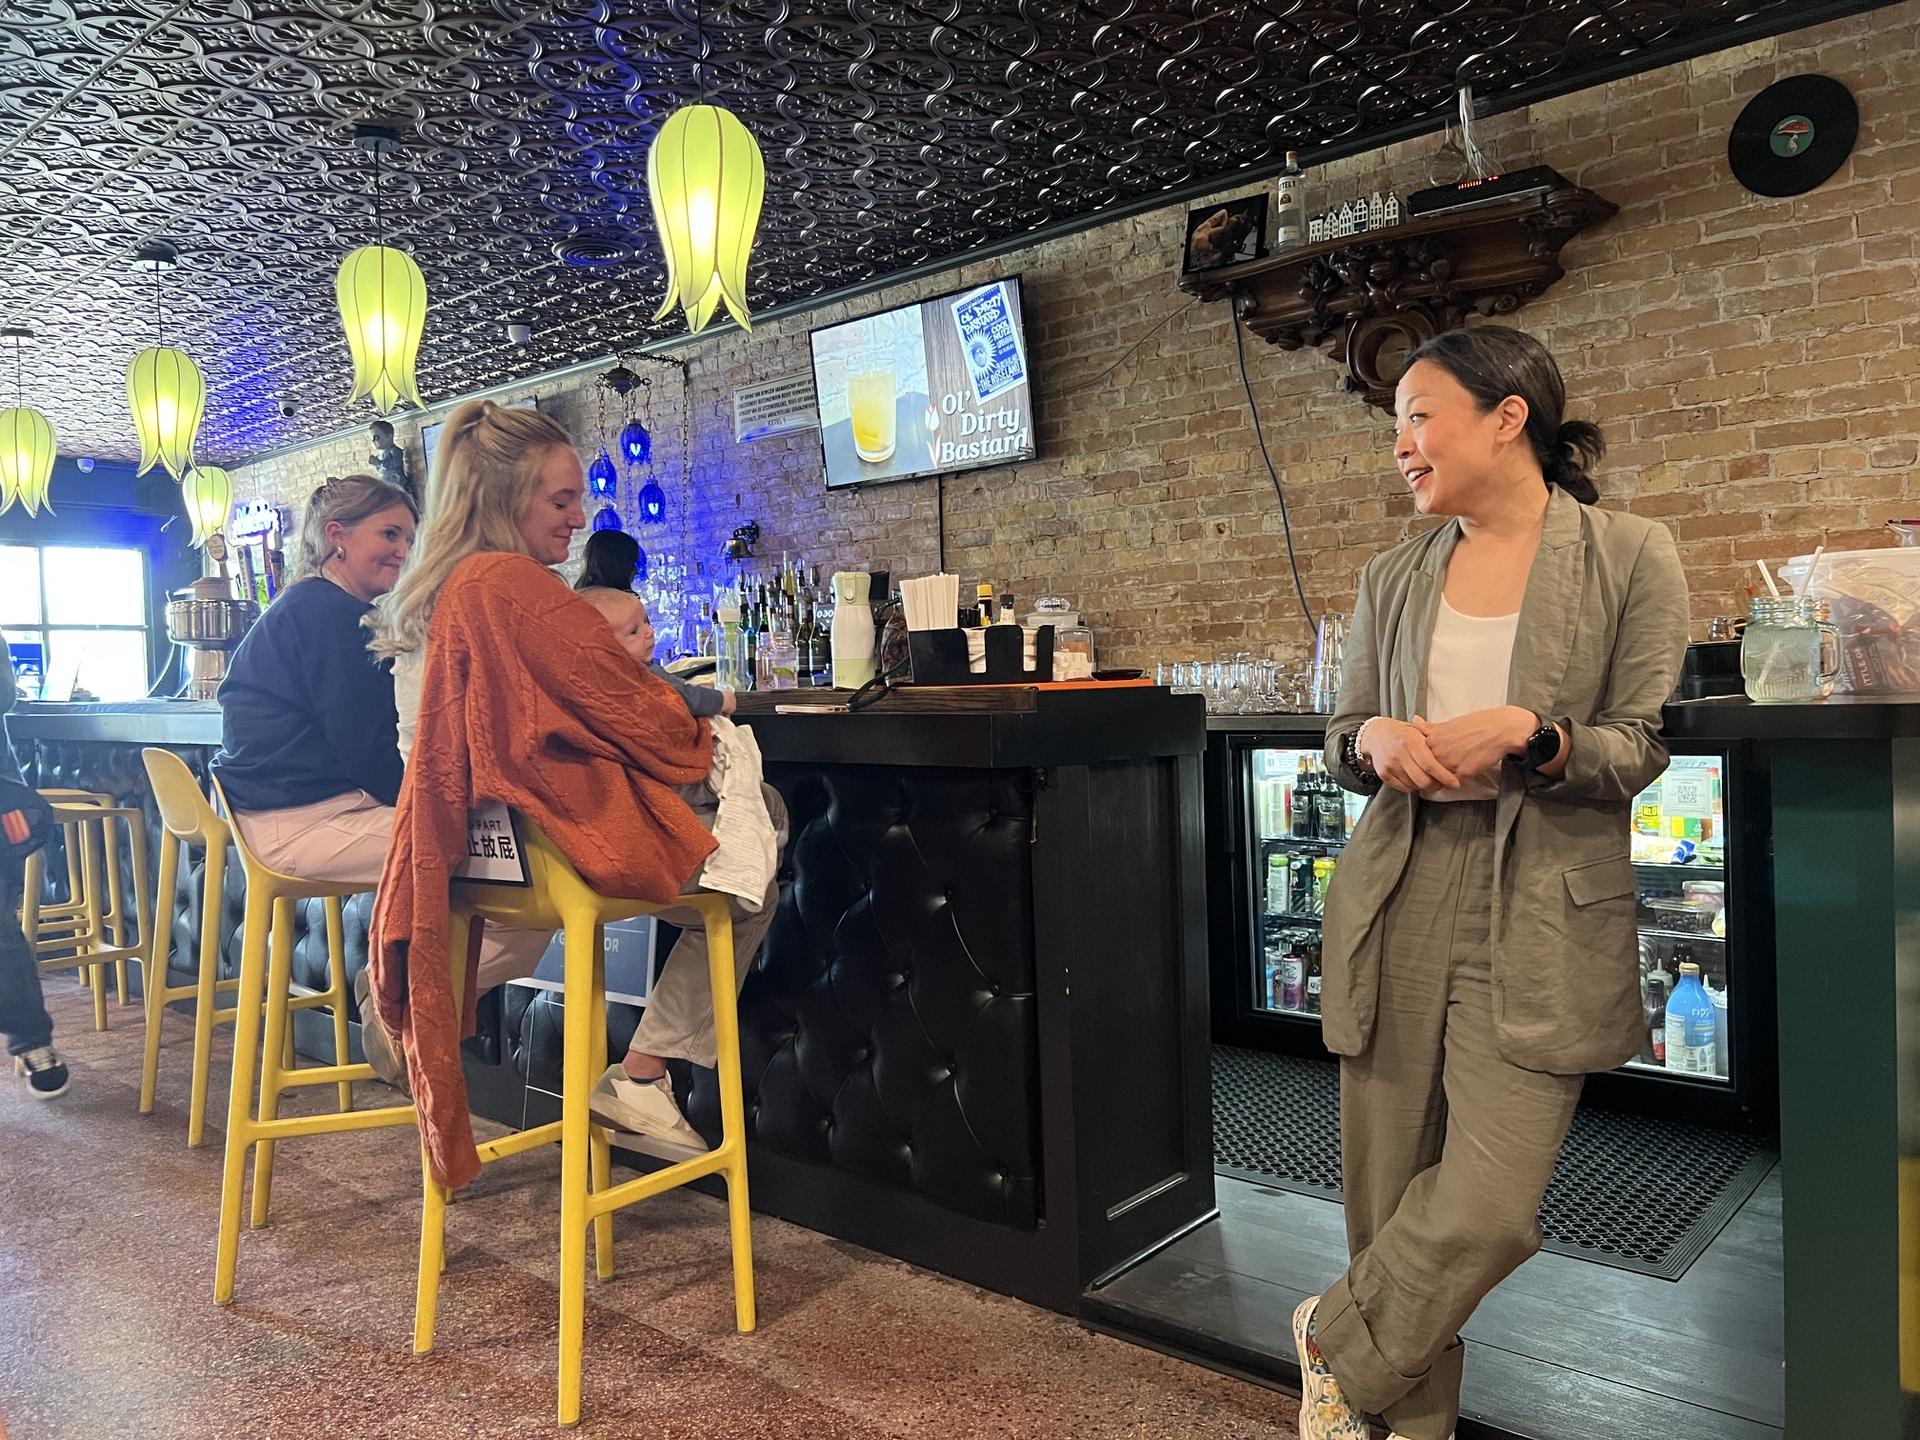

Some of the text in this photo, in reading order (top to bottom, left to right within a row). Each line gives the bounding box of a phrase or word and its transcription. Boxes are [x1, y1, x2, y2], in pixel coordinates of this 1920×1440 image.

[961, 309, 1000, 334] BASTARD
[960, 406, 1020, 436] Dirty
[941, 427, 1028, 464] Bastard
[477, 820, 501, 831] FART
